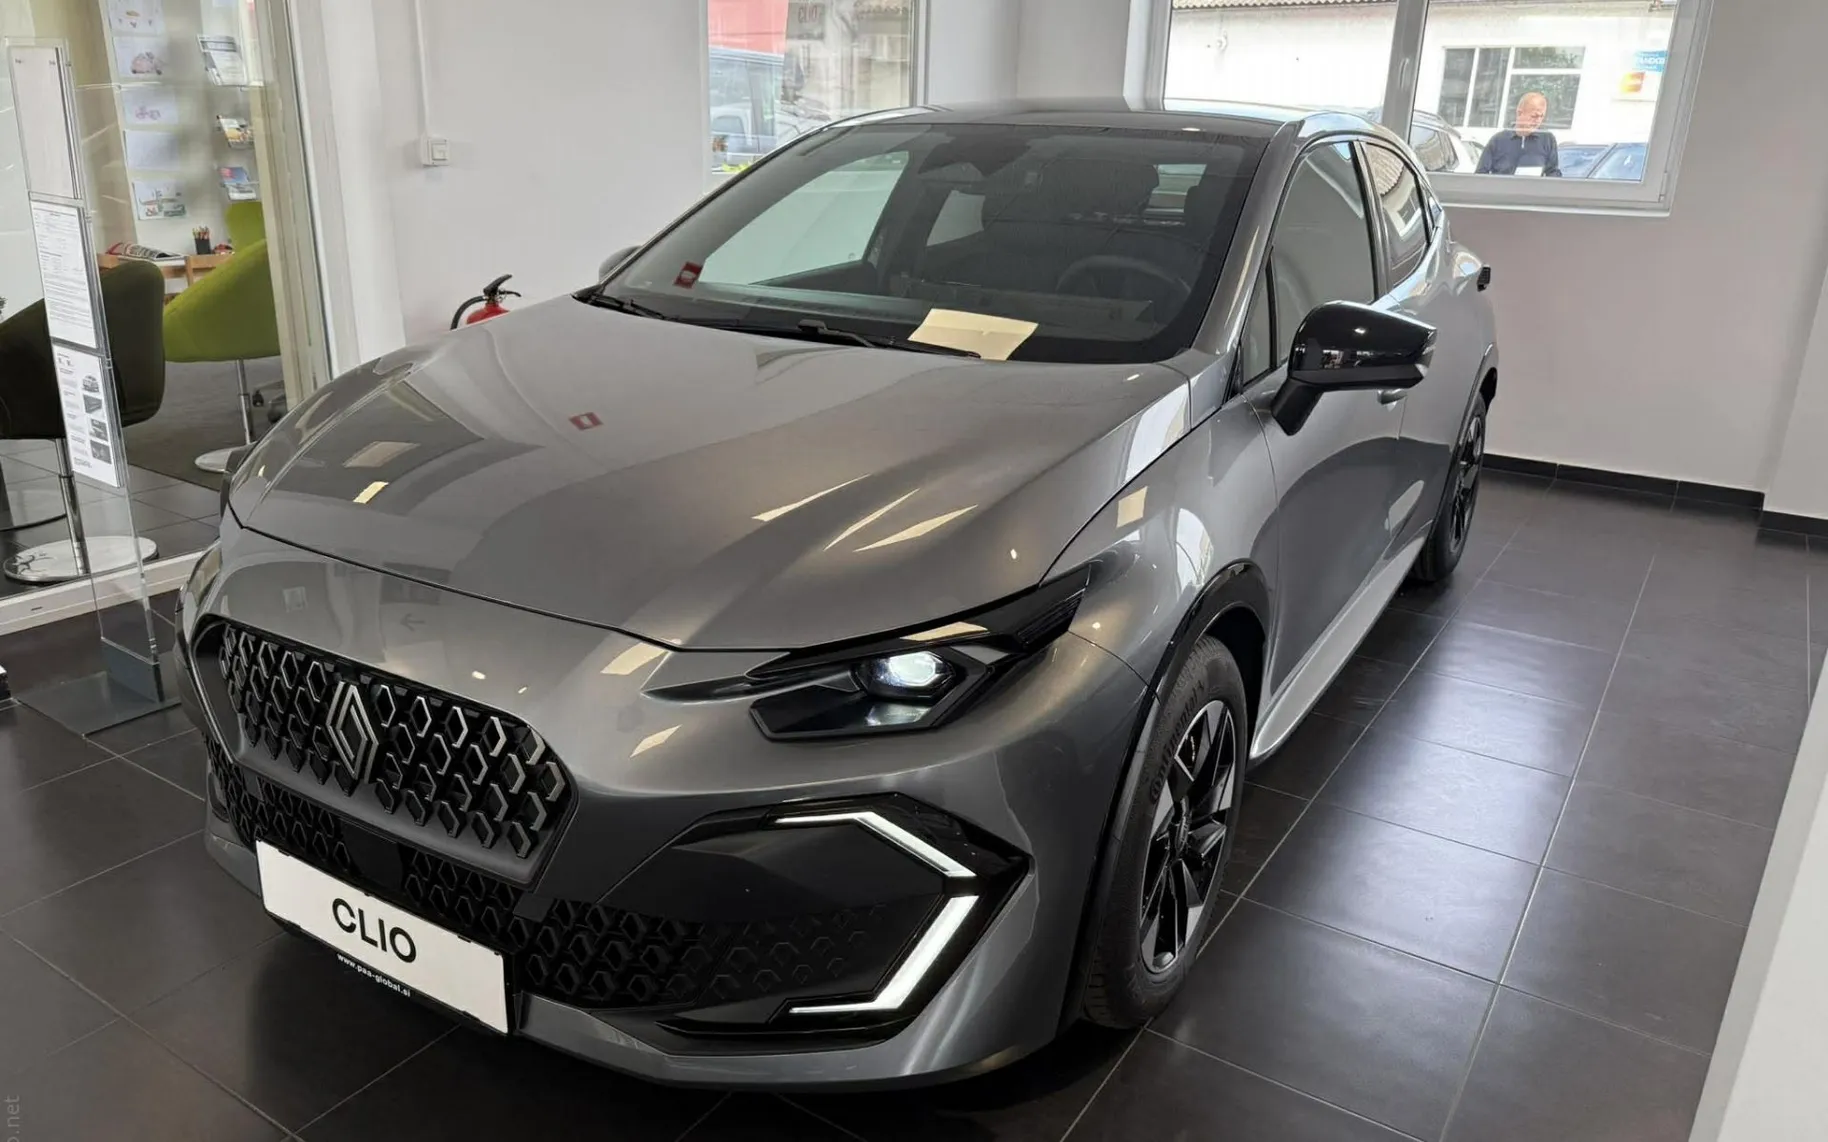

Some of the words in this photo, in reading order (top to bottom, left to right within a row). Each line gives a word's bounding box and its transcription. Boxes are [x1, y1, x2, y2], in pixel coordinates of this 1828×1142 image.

[1150, 687, 1198, 804] Continental
[332, 897, 417, 963] CLIO
[336, 952, 411, 997] www.paa-global.si
